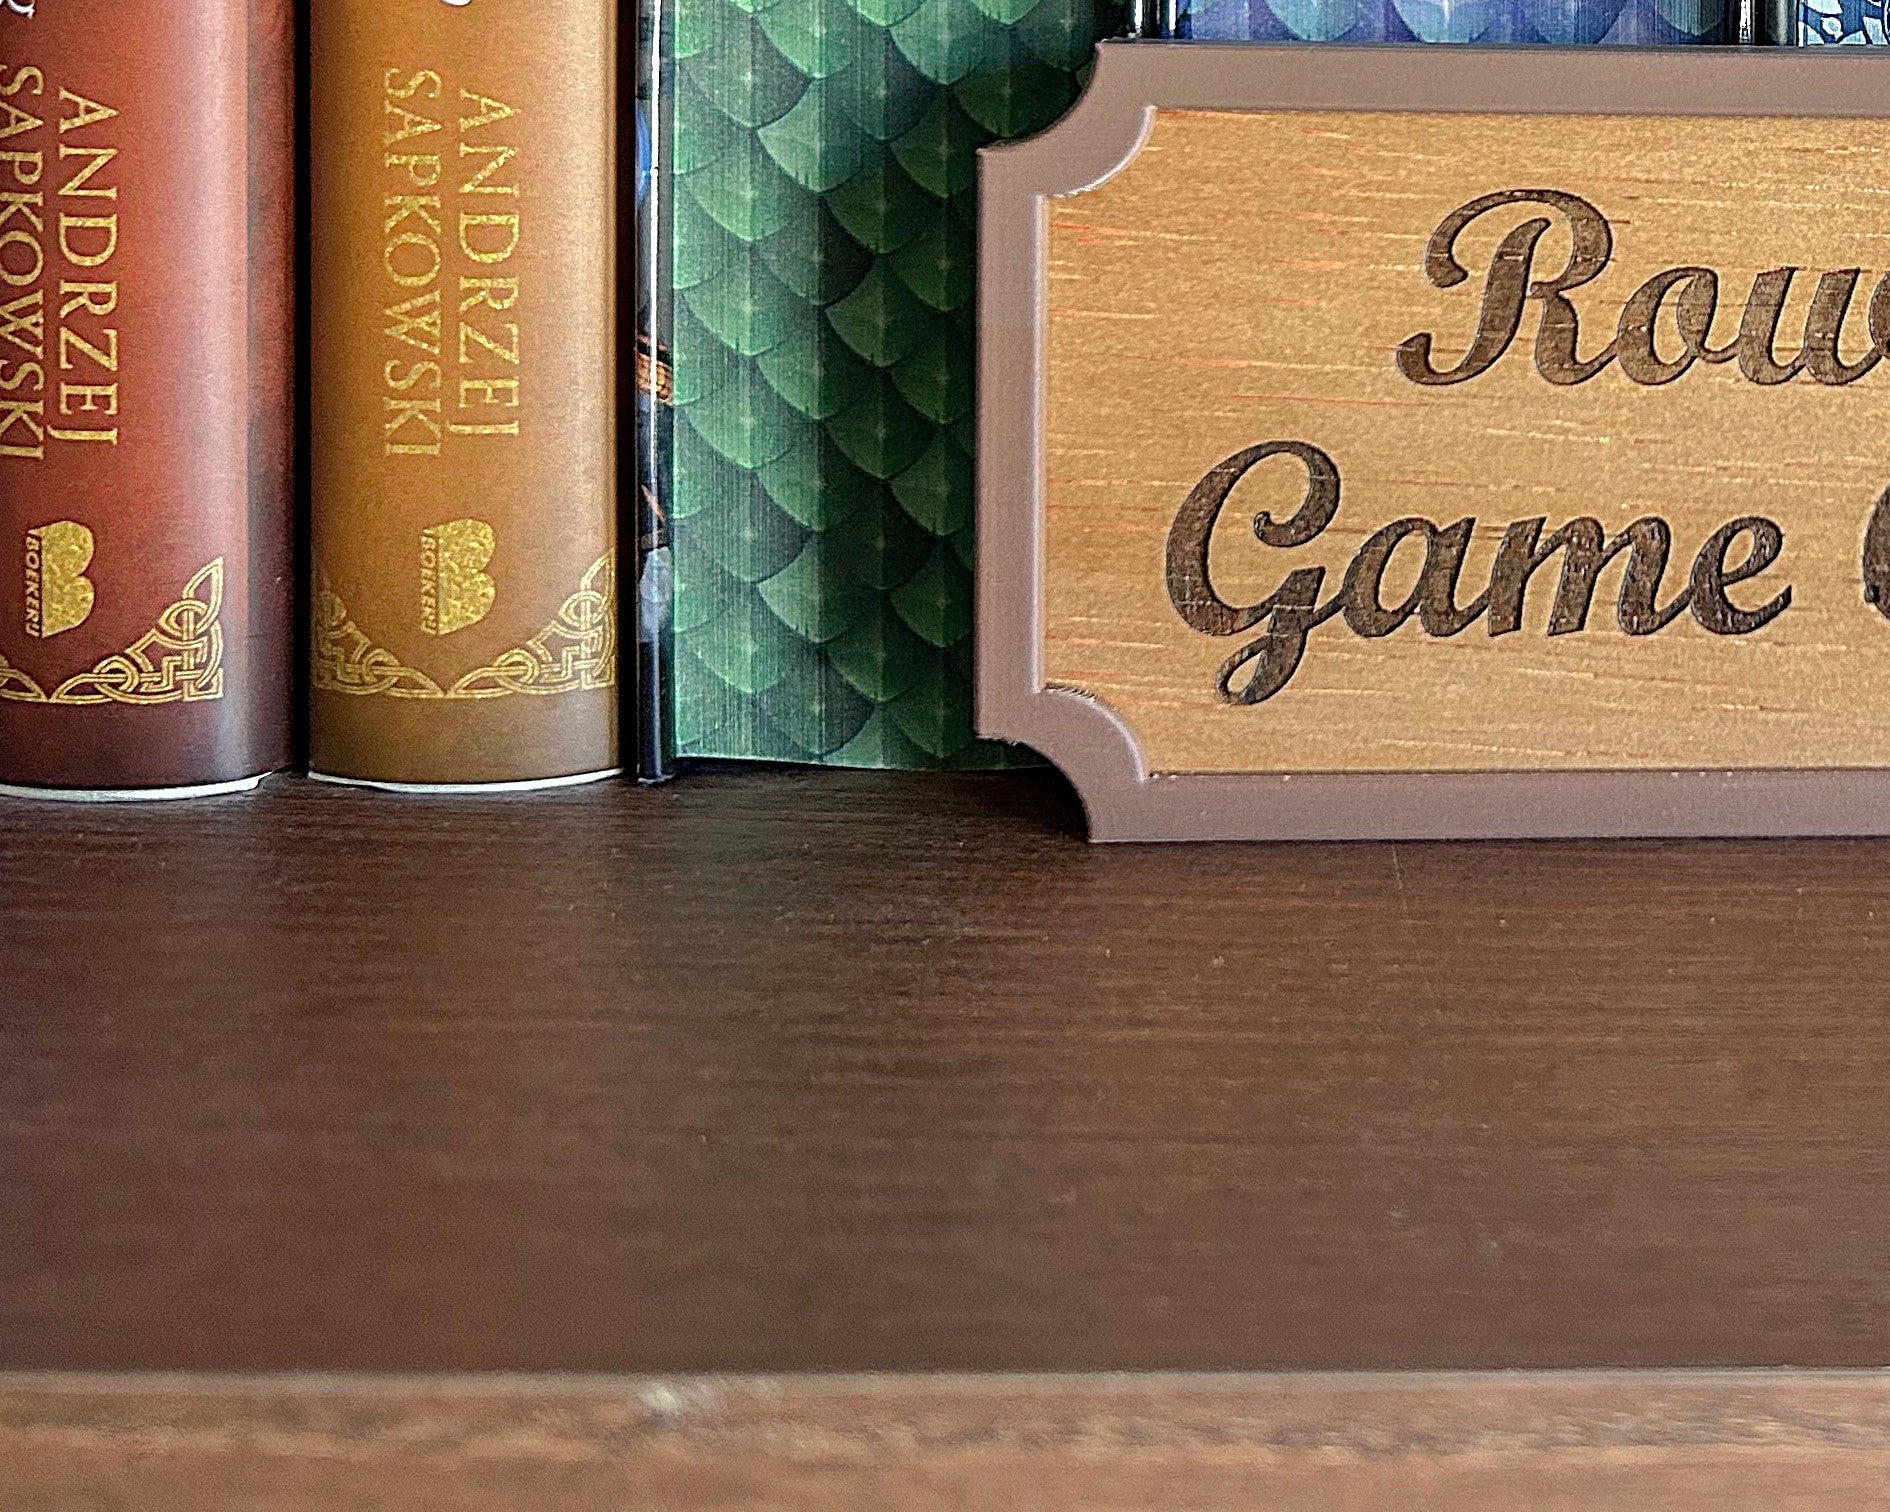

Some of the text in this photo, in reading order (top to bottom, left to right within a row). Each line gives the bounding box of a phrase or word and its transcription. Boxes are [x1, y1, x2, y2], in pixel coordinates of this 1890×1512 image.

[0, 64, 44, 460] SAPKOWSKI
[47, 87, 119, 445] ANDRZEJ
[382, 66, 442, 457] SAPKOWSKI
[449, 91, 521, 438] ANDRZEJ
[1163, 439, 1795, 707] Game
